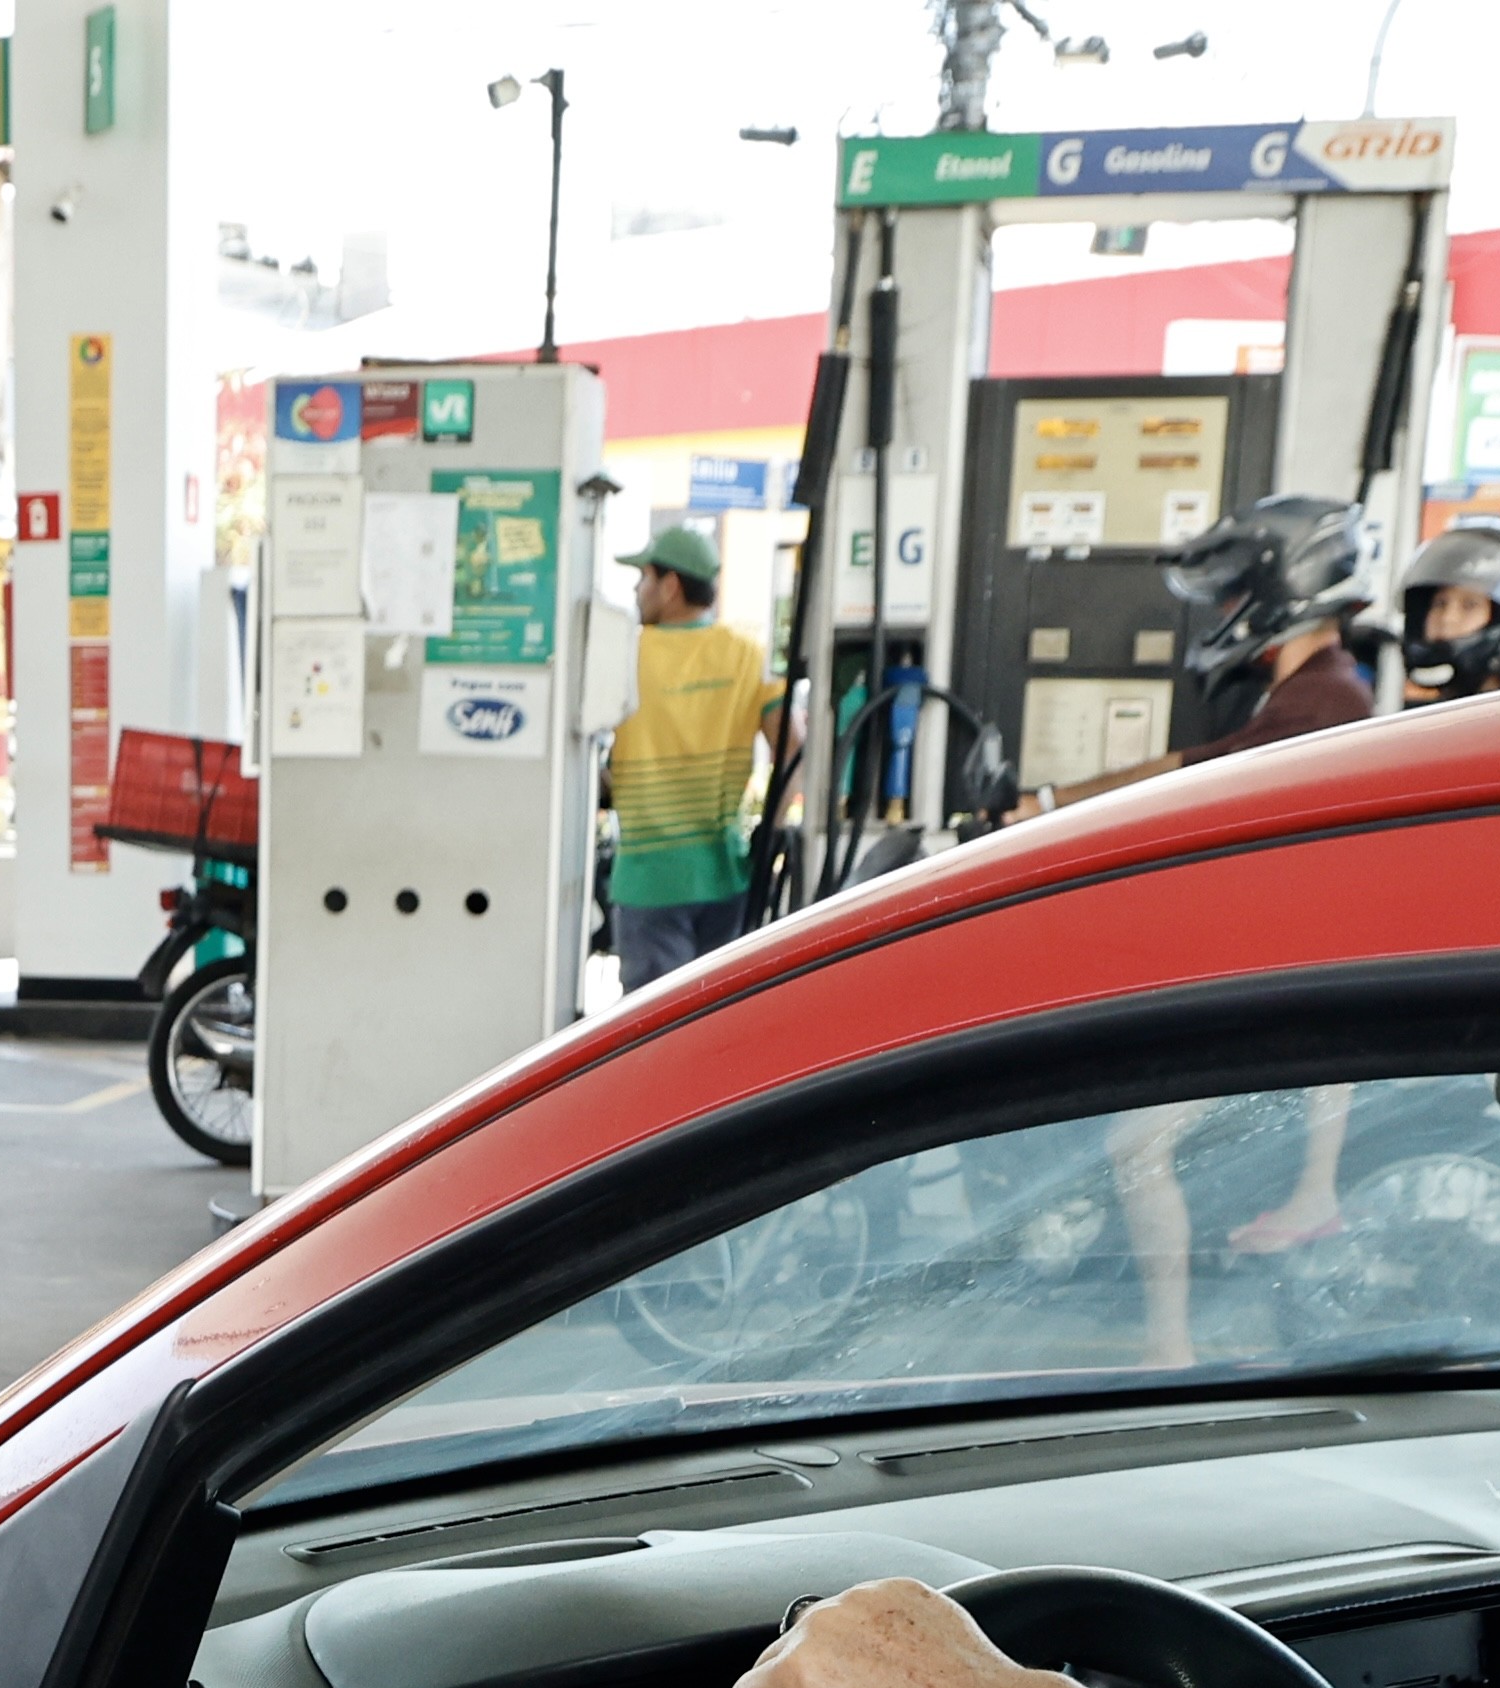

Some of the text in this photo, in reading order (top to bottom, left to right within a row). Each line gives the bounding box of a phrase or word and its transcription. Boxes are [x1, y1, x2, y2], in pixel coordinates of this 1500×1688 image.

[1047, 139, 1211, 184] G Gasolina
[1250, 131, 1289, 176] G
[1322, 121, 1444, 161] GRID
[849, 150, 1012, 194] E Etanol
[851, 530, 875, 566] E
[899, 526, 924, 565] G
